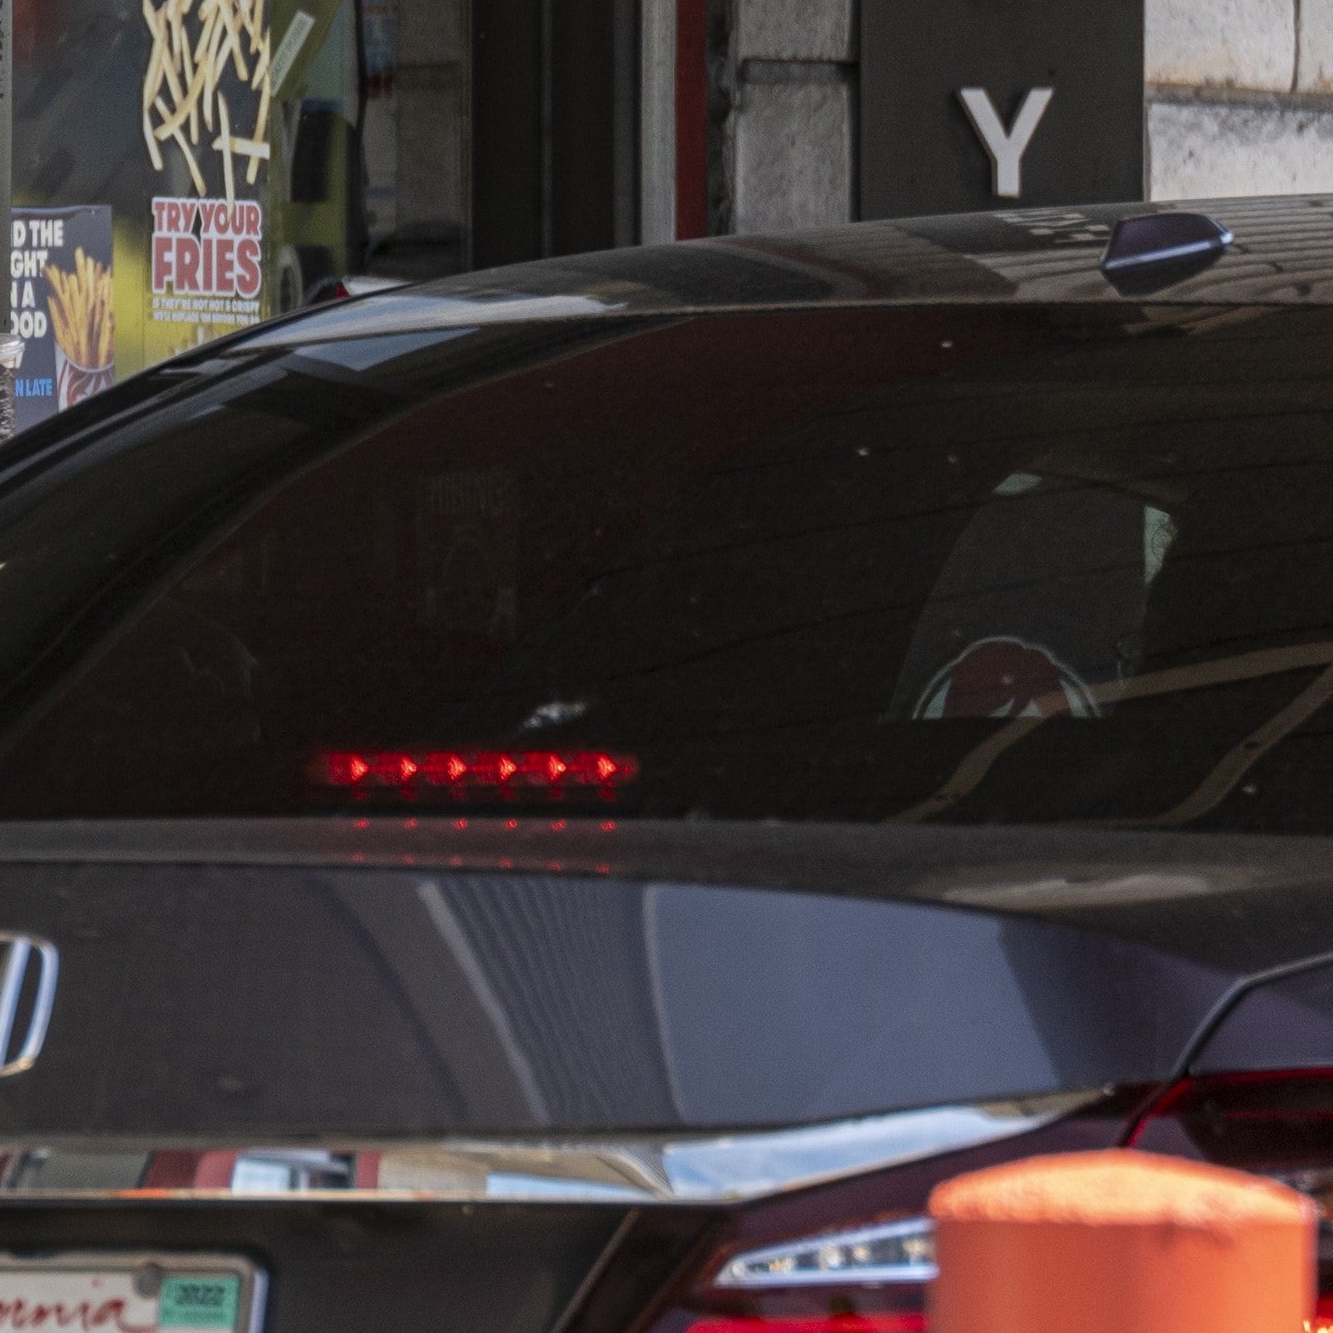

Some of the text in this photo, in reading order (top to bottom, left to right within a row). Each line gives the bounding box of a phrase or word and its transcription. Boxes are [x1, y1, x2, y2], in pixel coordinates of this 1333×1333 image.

[154, 201, 260, 236] TRY YOUR
[29, 219, 64, 247] THE
[154, 236, 260, 295] FRIES
[22, 280, 36, 308] A
[25, 378, 53, 397] LATE
